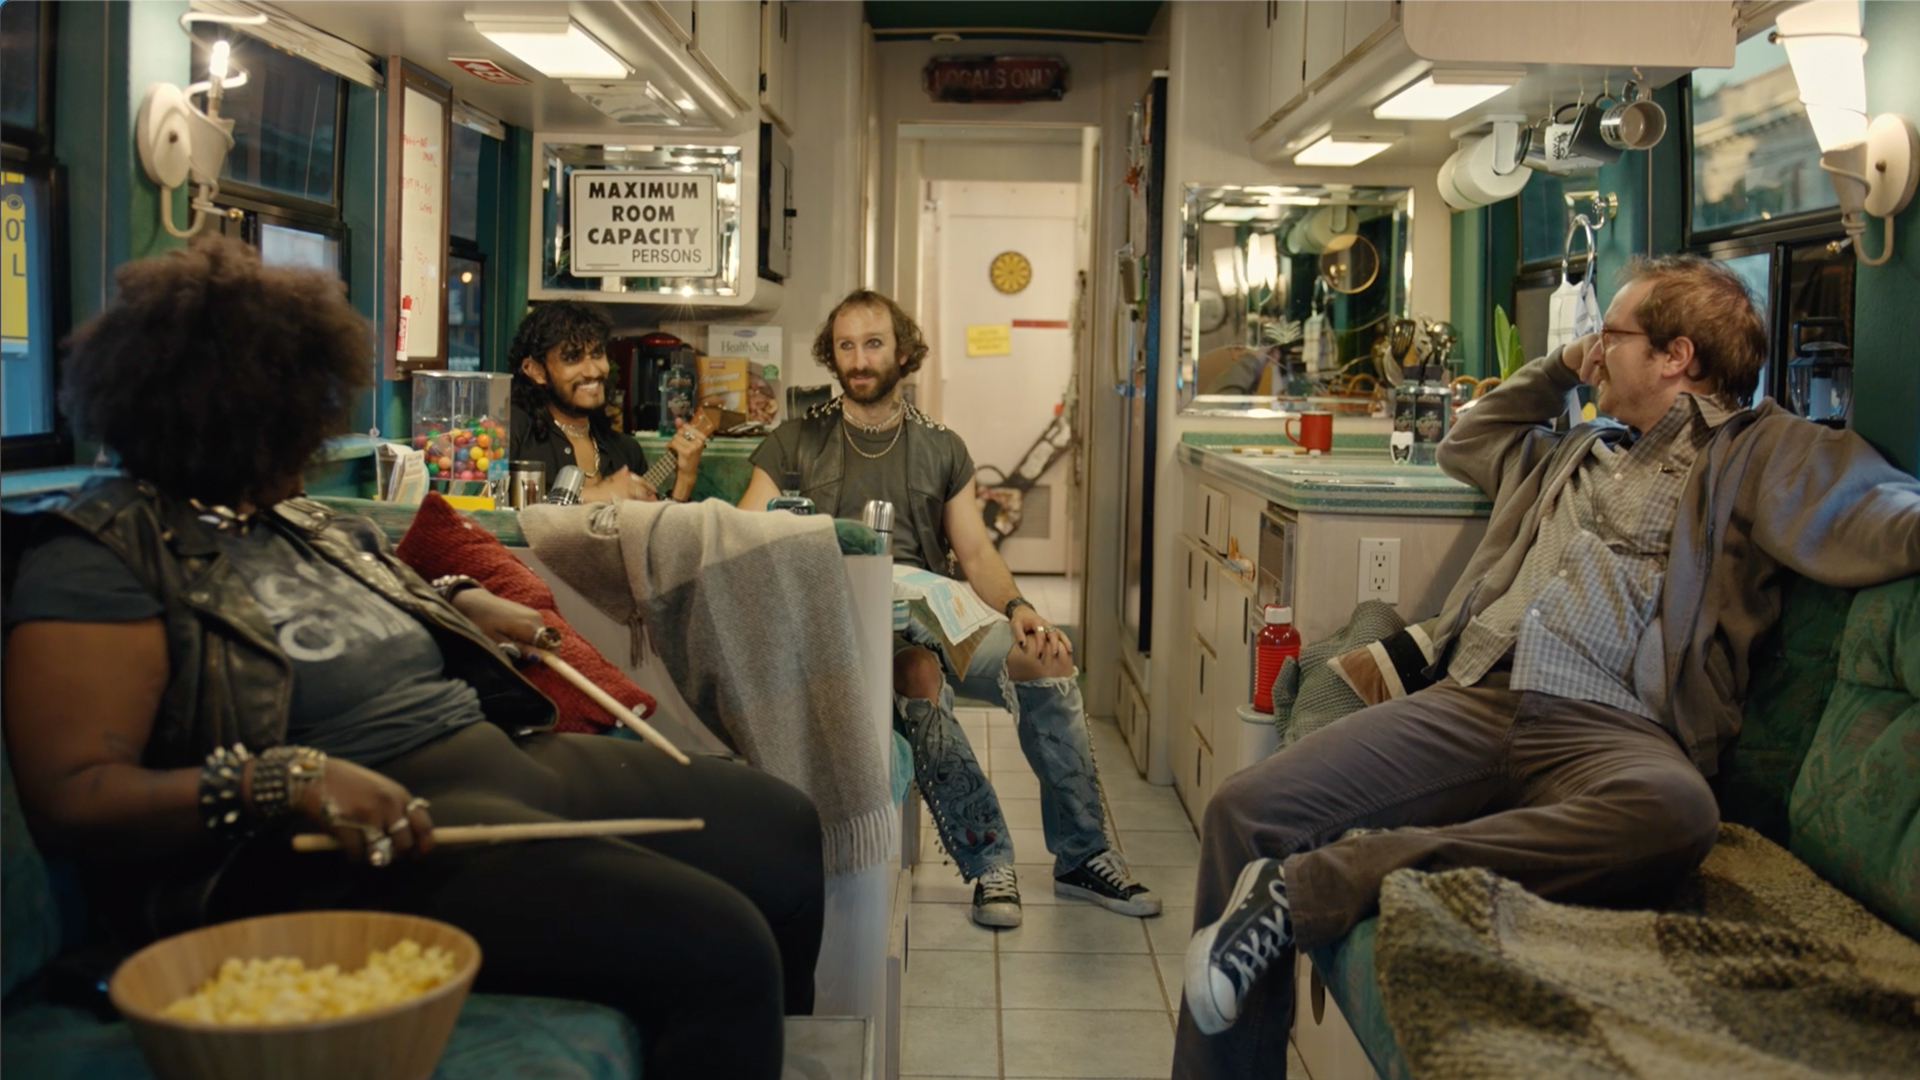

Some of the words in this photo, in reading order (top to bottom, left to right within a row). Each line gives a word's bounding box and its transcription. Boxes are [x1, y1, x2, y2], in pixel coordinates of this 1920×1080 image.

[934, 68, 1007, 90] LOCALS
[588, 181, 699, 199] MAXIMUM
[612, 205, 675, 222] ROOM
[587, 227, 700, 245] CAPACITY
[631, 249, 702, 264] PERSONS
